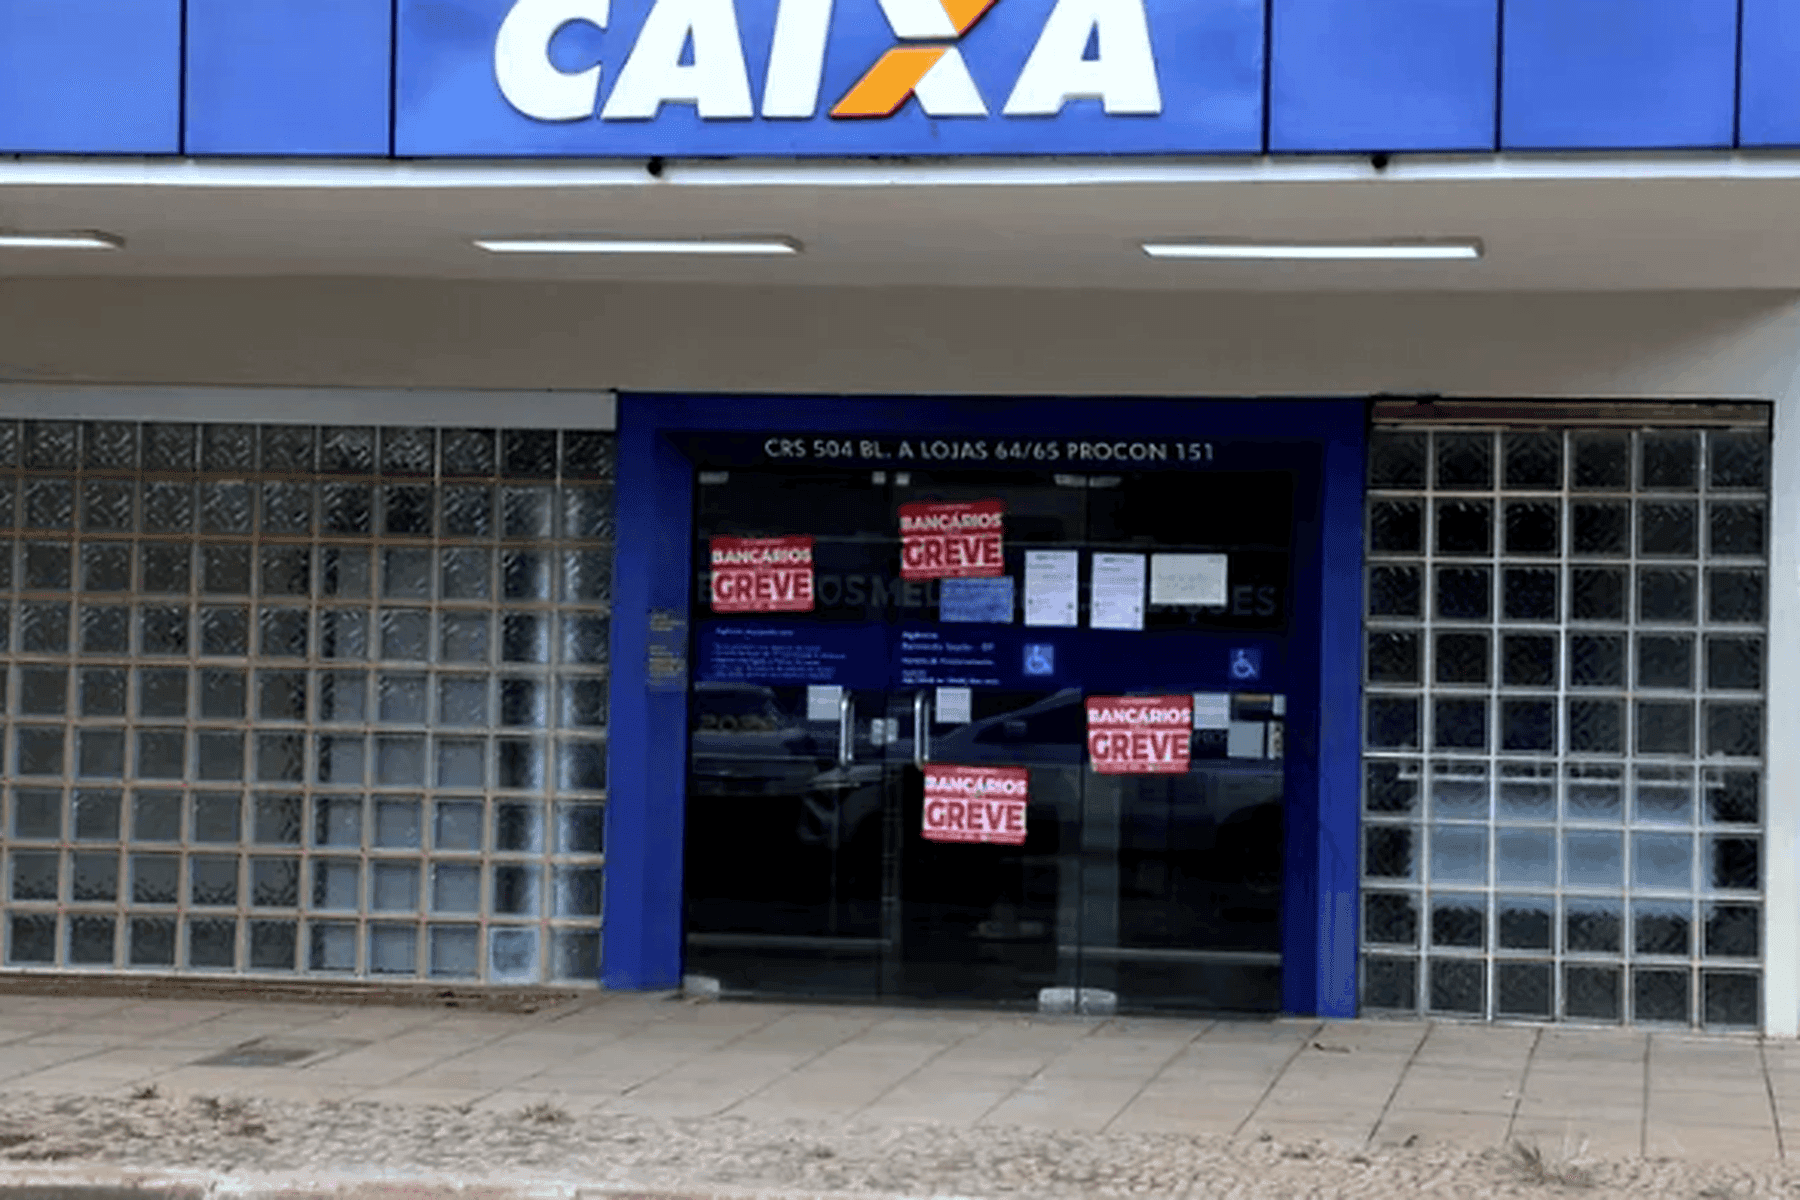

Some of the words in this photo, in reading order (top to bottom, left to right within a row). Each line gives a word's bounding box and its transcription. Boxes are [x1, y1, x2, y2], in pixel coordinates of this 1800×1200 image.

[494, 0, 1162, 120] CAIXA
[764, 438, 806, 458] CRS
[813, 439, 852, 458] 504
[860, 440, 891, 459] BL.
[899, 440, 914, 459] A
[920, 440, 989, 460] LOJAS
[994, 441, 1060, 460] 64/65
[1066, 441, 1167, 461] PROCON
[1175, 442, 1214, 461] 151
[900, 511, 1002, 531] BANCÁRIOS
[904, 538, 1000, 567] GREVE
[715, 572, 811, 599] GREVE
[1088, 706, 1191, 724] BANCÁRIOS
[1090, 733, 1189, 760] GREVE
[925, 774, 1026, 794] BANCÁRIOS
[926, 801, 1024, 830] GREVE
